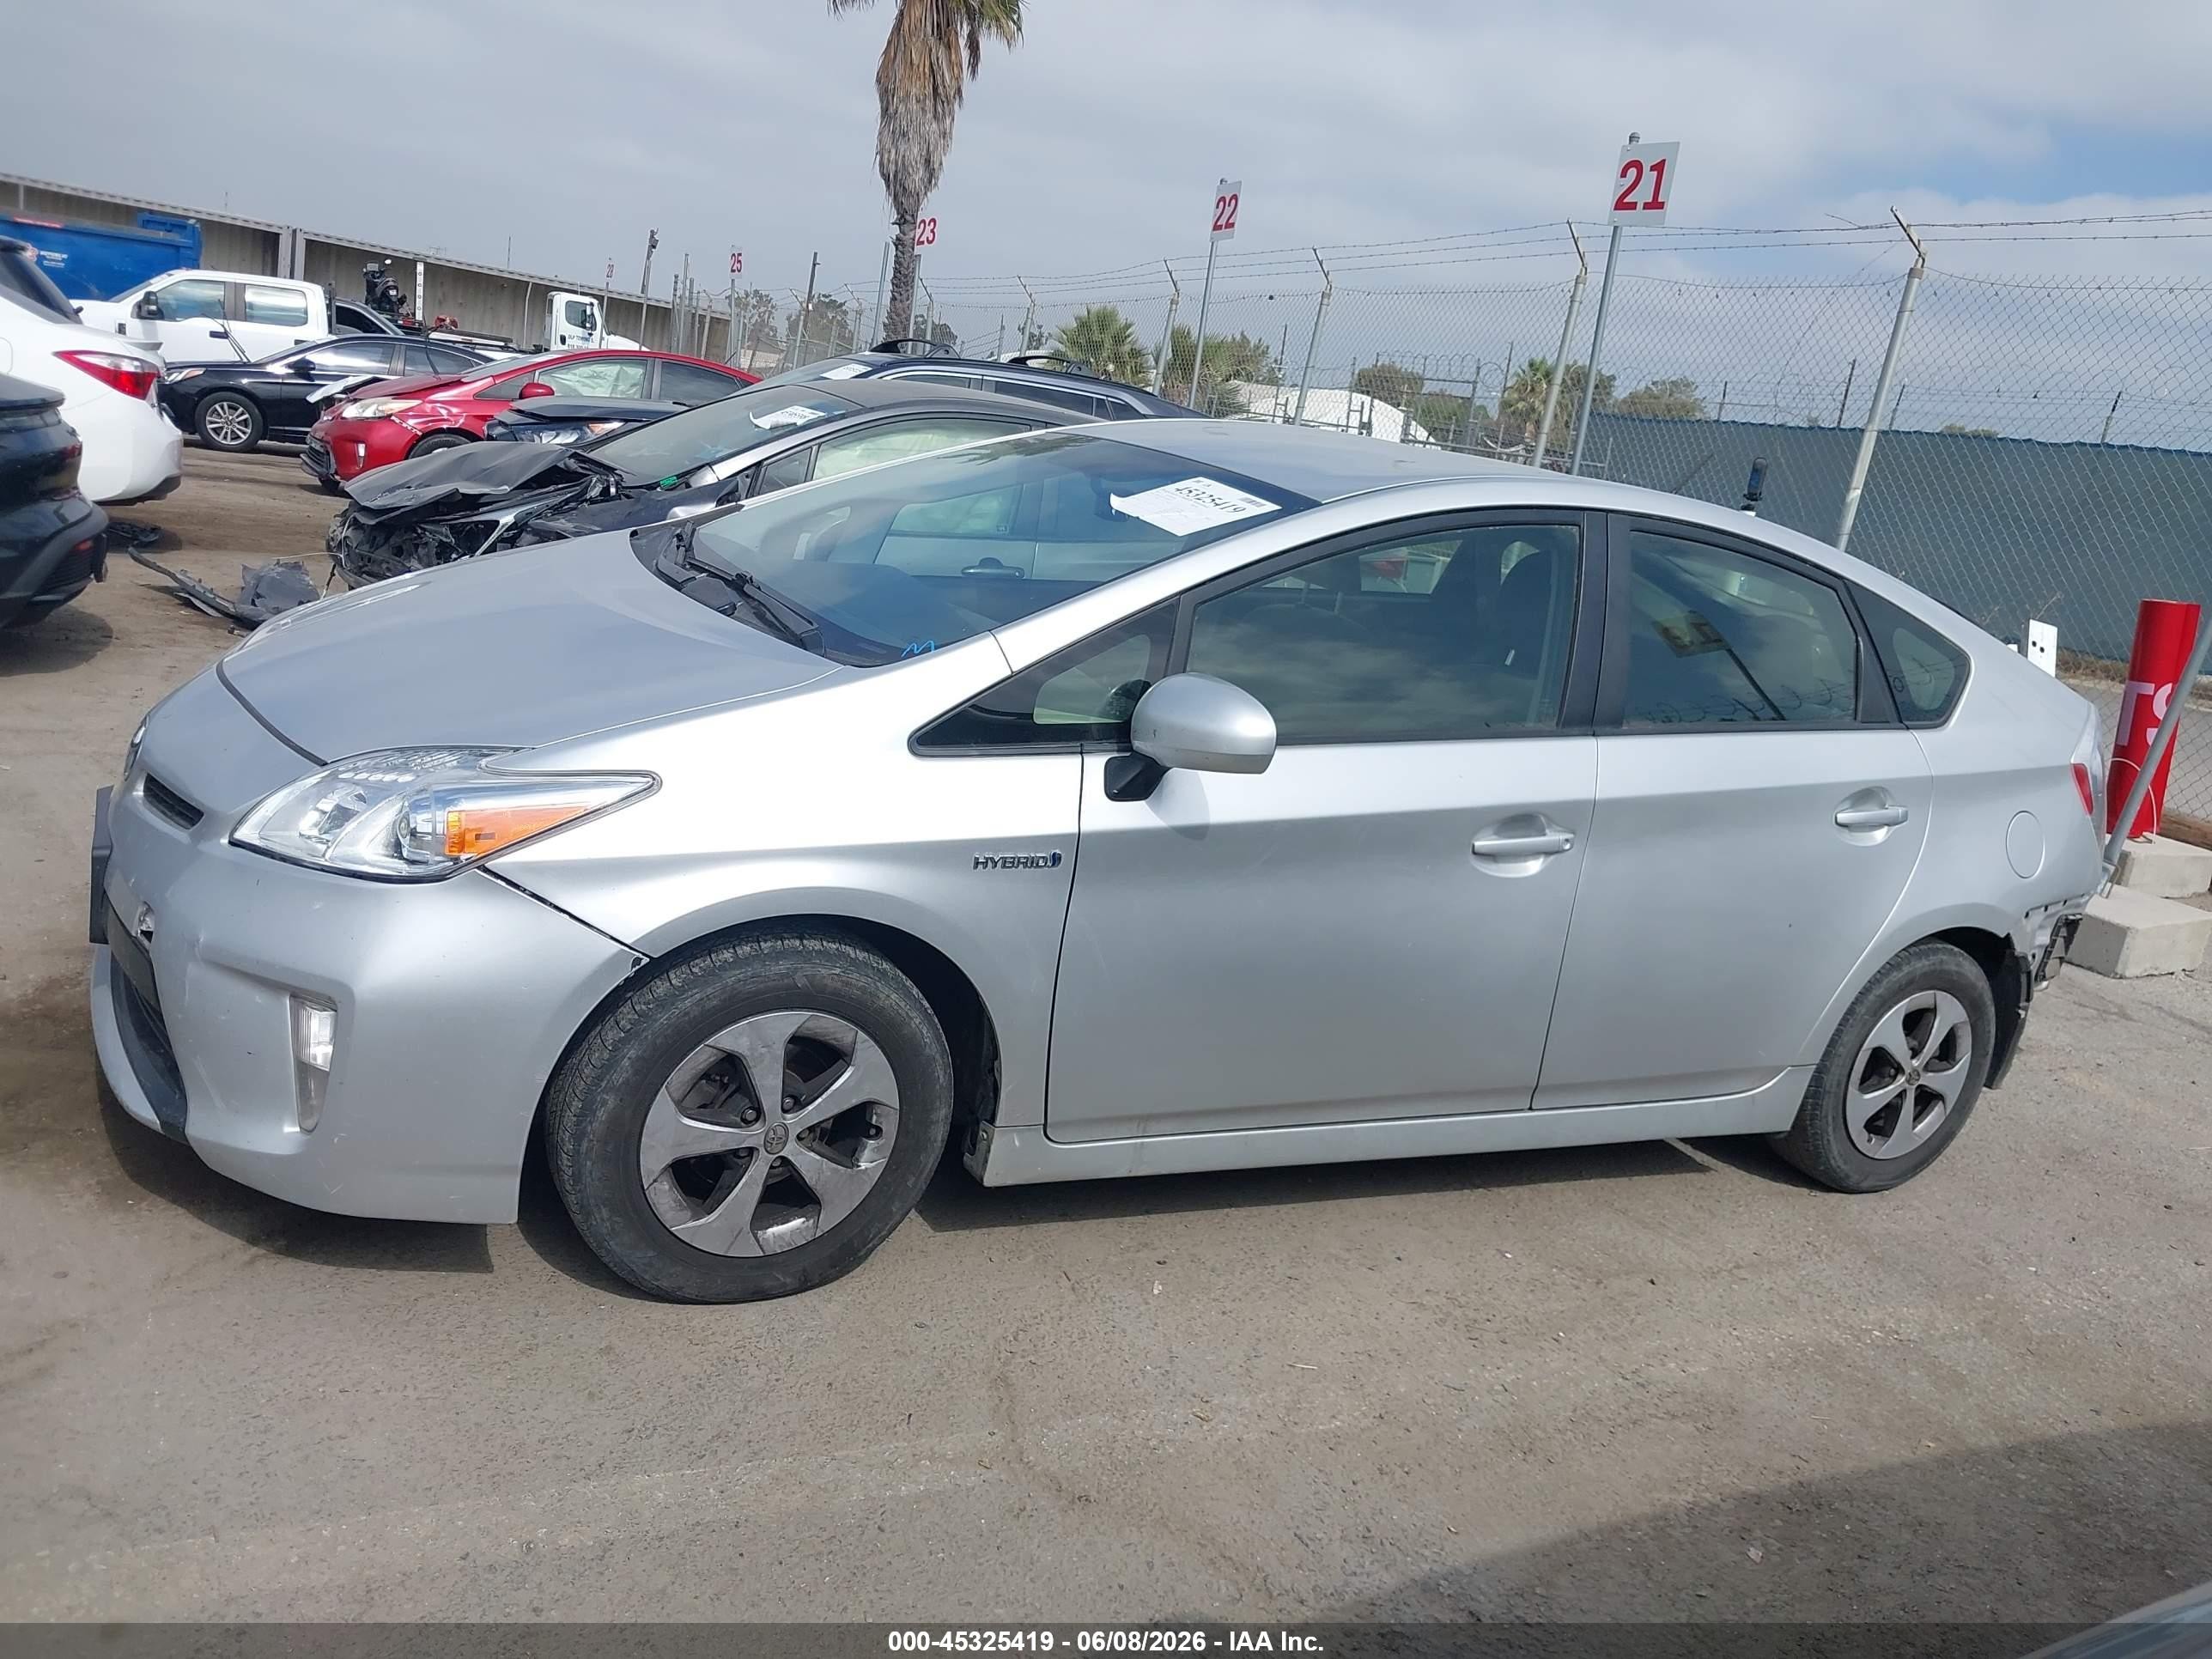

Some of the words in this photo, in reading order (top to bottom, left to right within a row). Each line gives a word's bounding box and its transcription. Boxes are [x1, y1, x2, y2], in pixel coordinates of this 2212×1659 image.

[1613, 158, 1667, 211] 21
[1212, 193, 1238, 231] 22
[916, 217, 937, 246] 23
[730, 252, 743, 273] 25
[1174, 486, 1247, 514] 45325419
[973, 854, 1048, 870] HYBRID
